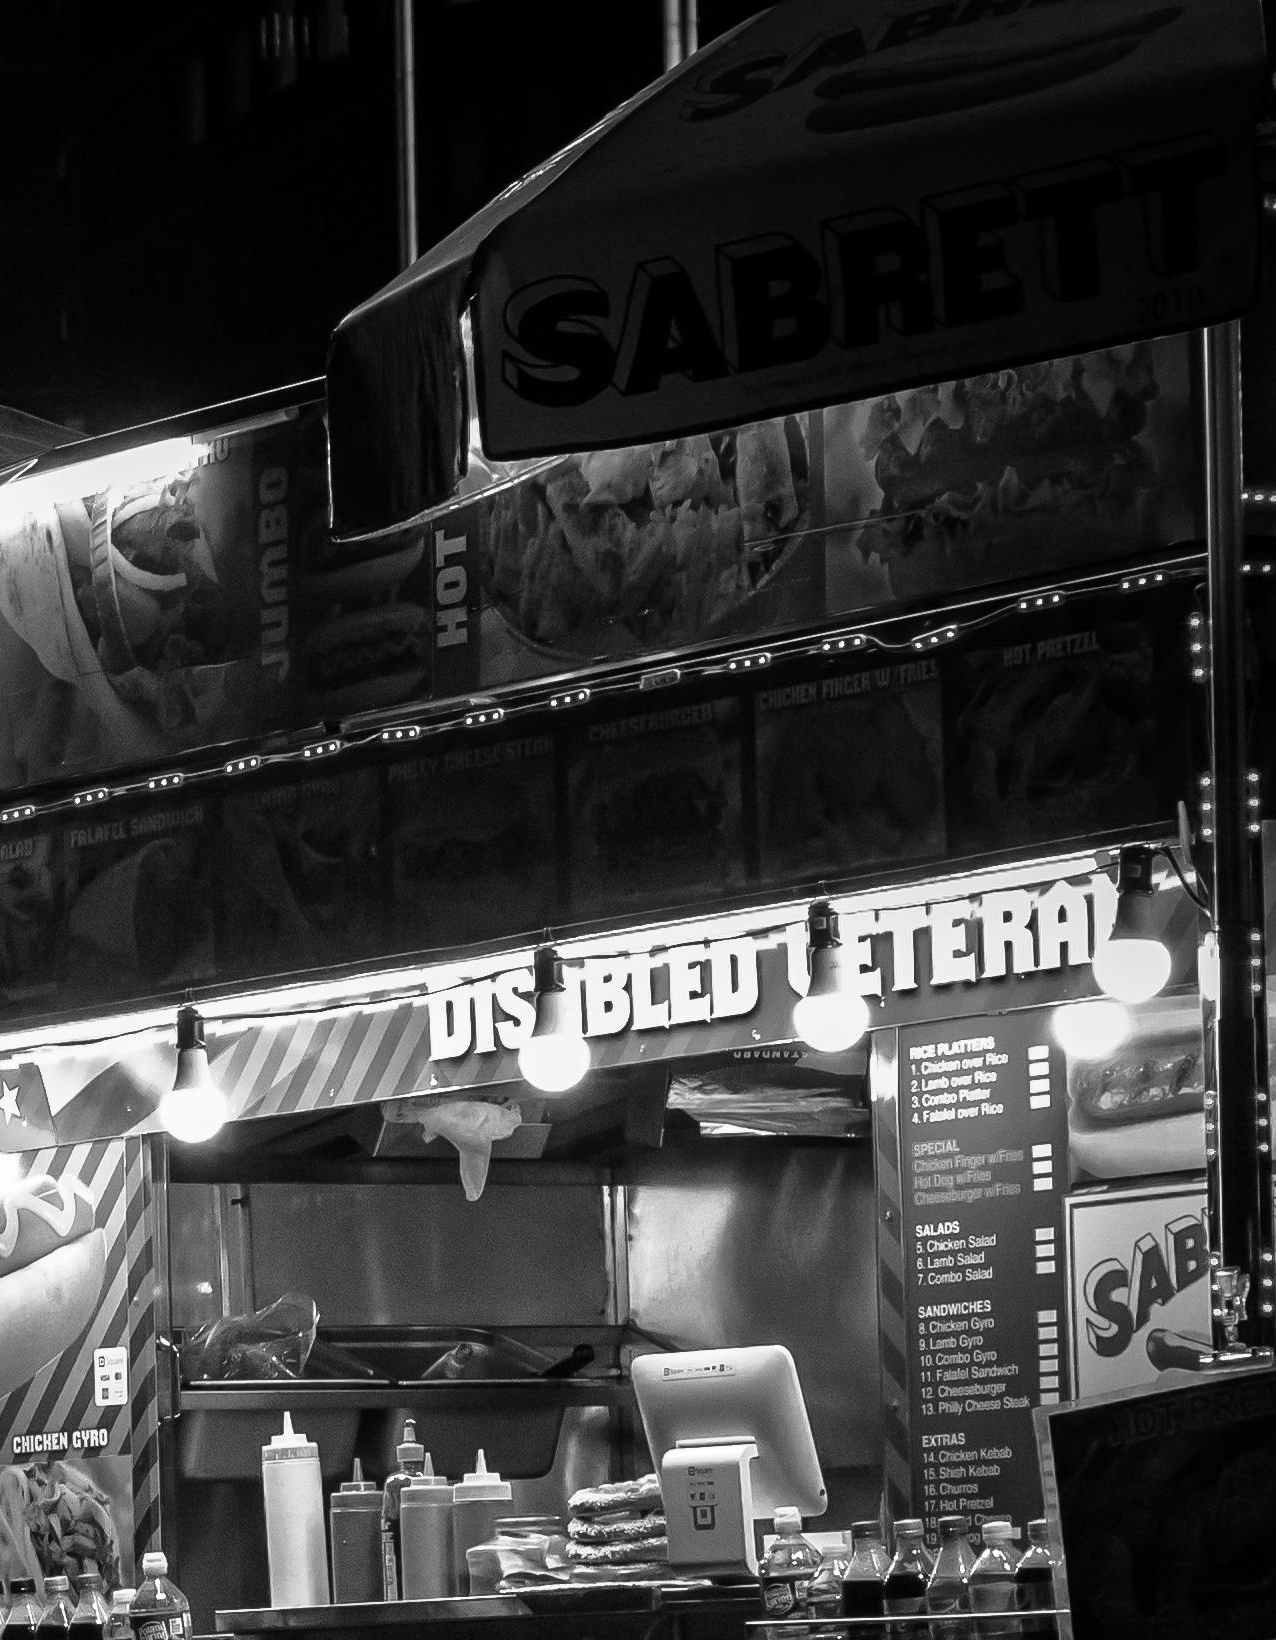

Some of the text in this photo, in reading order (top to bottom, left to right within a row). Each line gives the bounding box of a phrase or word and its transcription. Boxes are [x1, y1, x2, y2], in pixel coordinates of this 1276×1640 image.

[501, 129, 1226, 407] SABRETT
[258, 466, 289, 682] JUMBO
[436, 527, 469, 648] HOT
[1003, 629, 1101, 668] HOT PRETZEL
[758, 685, 817, 712] CHICKEN
[820, 674, 871, 701] FINGER
[587, 702, 714, 742] CHEESEBURGER
[443, 748, 501, 775] CHEESE
[70, 806, 205, 848] FALAFEL SANDWICH
[428, 933, 760, 1063] DISBLED
[937, 1036, 995, 1056] PLATTERS
[922, 1076, 950, 1091] Lamb
[911, 1096, 921, 1108] 3.
[922, 1092, 958, 1107] Combo
[912, 1112, 922, 1124] 4.
[913, 1139, 960, 1157] SPECIAL
[915, 1220, 960, 1238] SALADS
[916, 1233, 997, 1254] 5. Chicken Salad
[916, 1251, 985, 1270] 6. Lamb Salad
[917, 1266, 993, 1286] 7. Combo Salad
[918, 1299, 992, 1318] SANDWICHES
[918, 1316, 995, 1334] 8. Chicken Gyro
[919, 1334, 984, 1351] 9. Lamb Gyro
[920, 1349, 998, 1367] 10. Combo Gyro
[921, 1363, 1019, 1383] 11. Falafel Sandwich
[921, 1382, 1007, 1399] 12. Cheeseburger
[922, 1395, 1031, 1416] 13. Philly Cheese Steak
[12, 1428, 109, 1454] CHICKEN GYRO
[922, 1432, 966, 1448] EXTRAS
[923, 1446, 1013, 1464] 14. Chicken Kebab
[923, 1464, 1001, 1480] 15. Shish Kebab
[924, 1483, 979, 1496] 16. Churros
[924, 1496, 994, 1513] 17. Hot Pretzel
